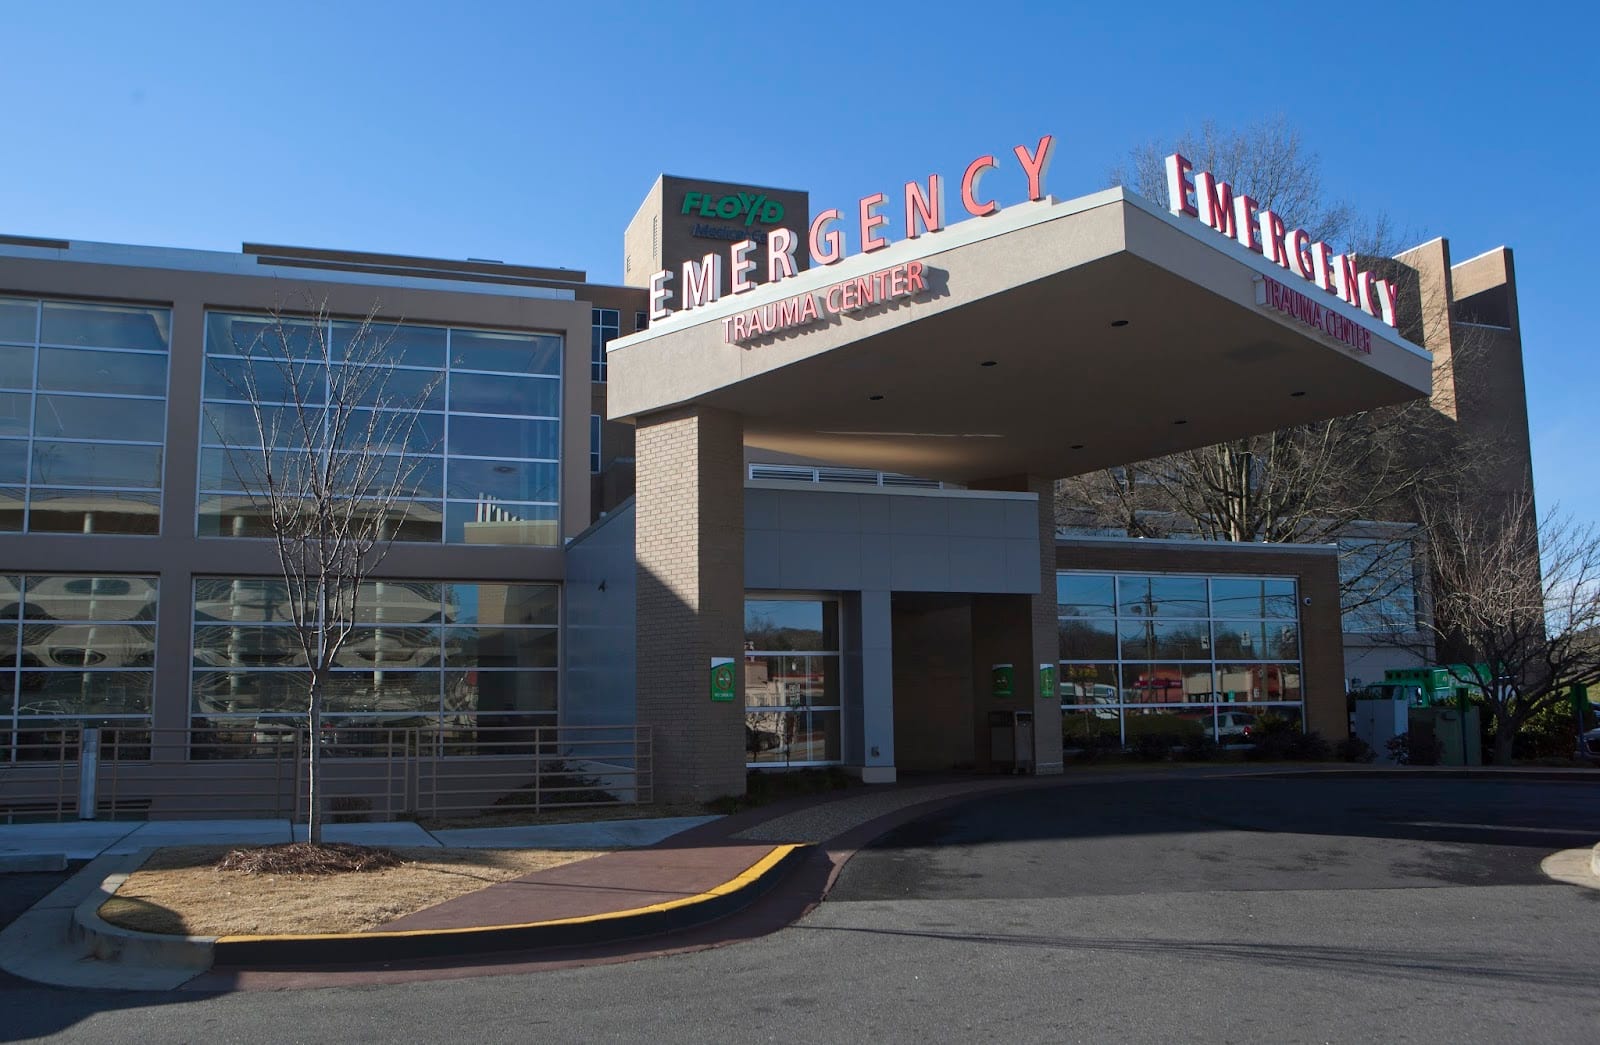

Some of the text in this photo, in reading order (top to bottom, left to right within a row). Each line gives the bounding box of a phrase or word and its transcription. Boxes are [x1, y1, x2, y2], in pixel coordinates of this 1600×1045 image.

[649, 135, 1056, 322] EMERGENCY
[681, 191, 785, 227] FLOYD
[1165, 153, 1398, 328] EMERGENCY
[721, 261, 925, 345] TRAUMA CENTER
[1263, 274, 1372, 355] TRAUMA CENTER
